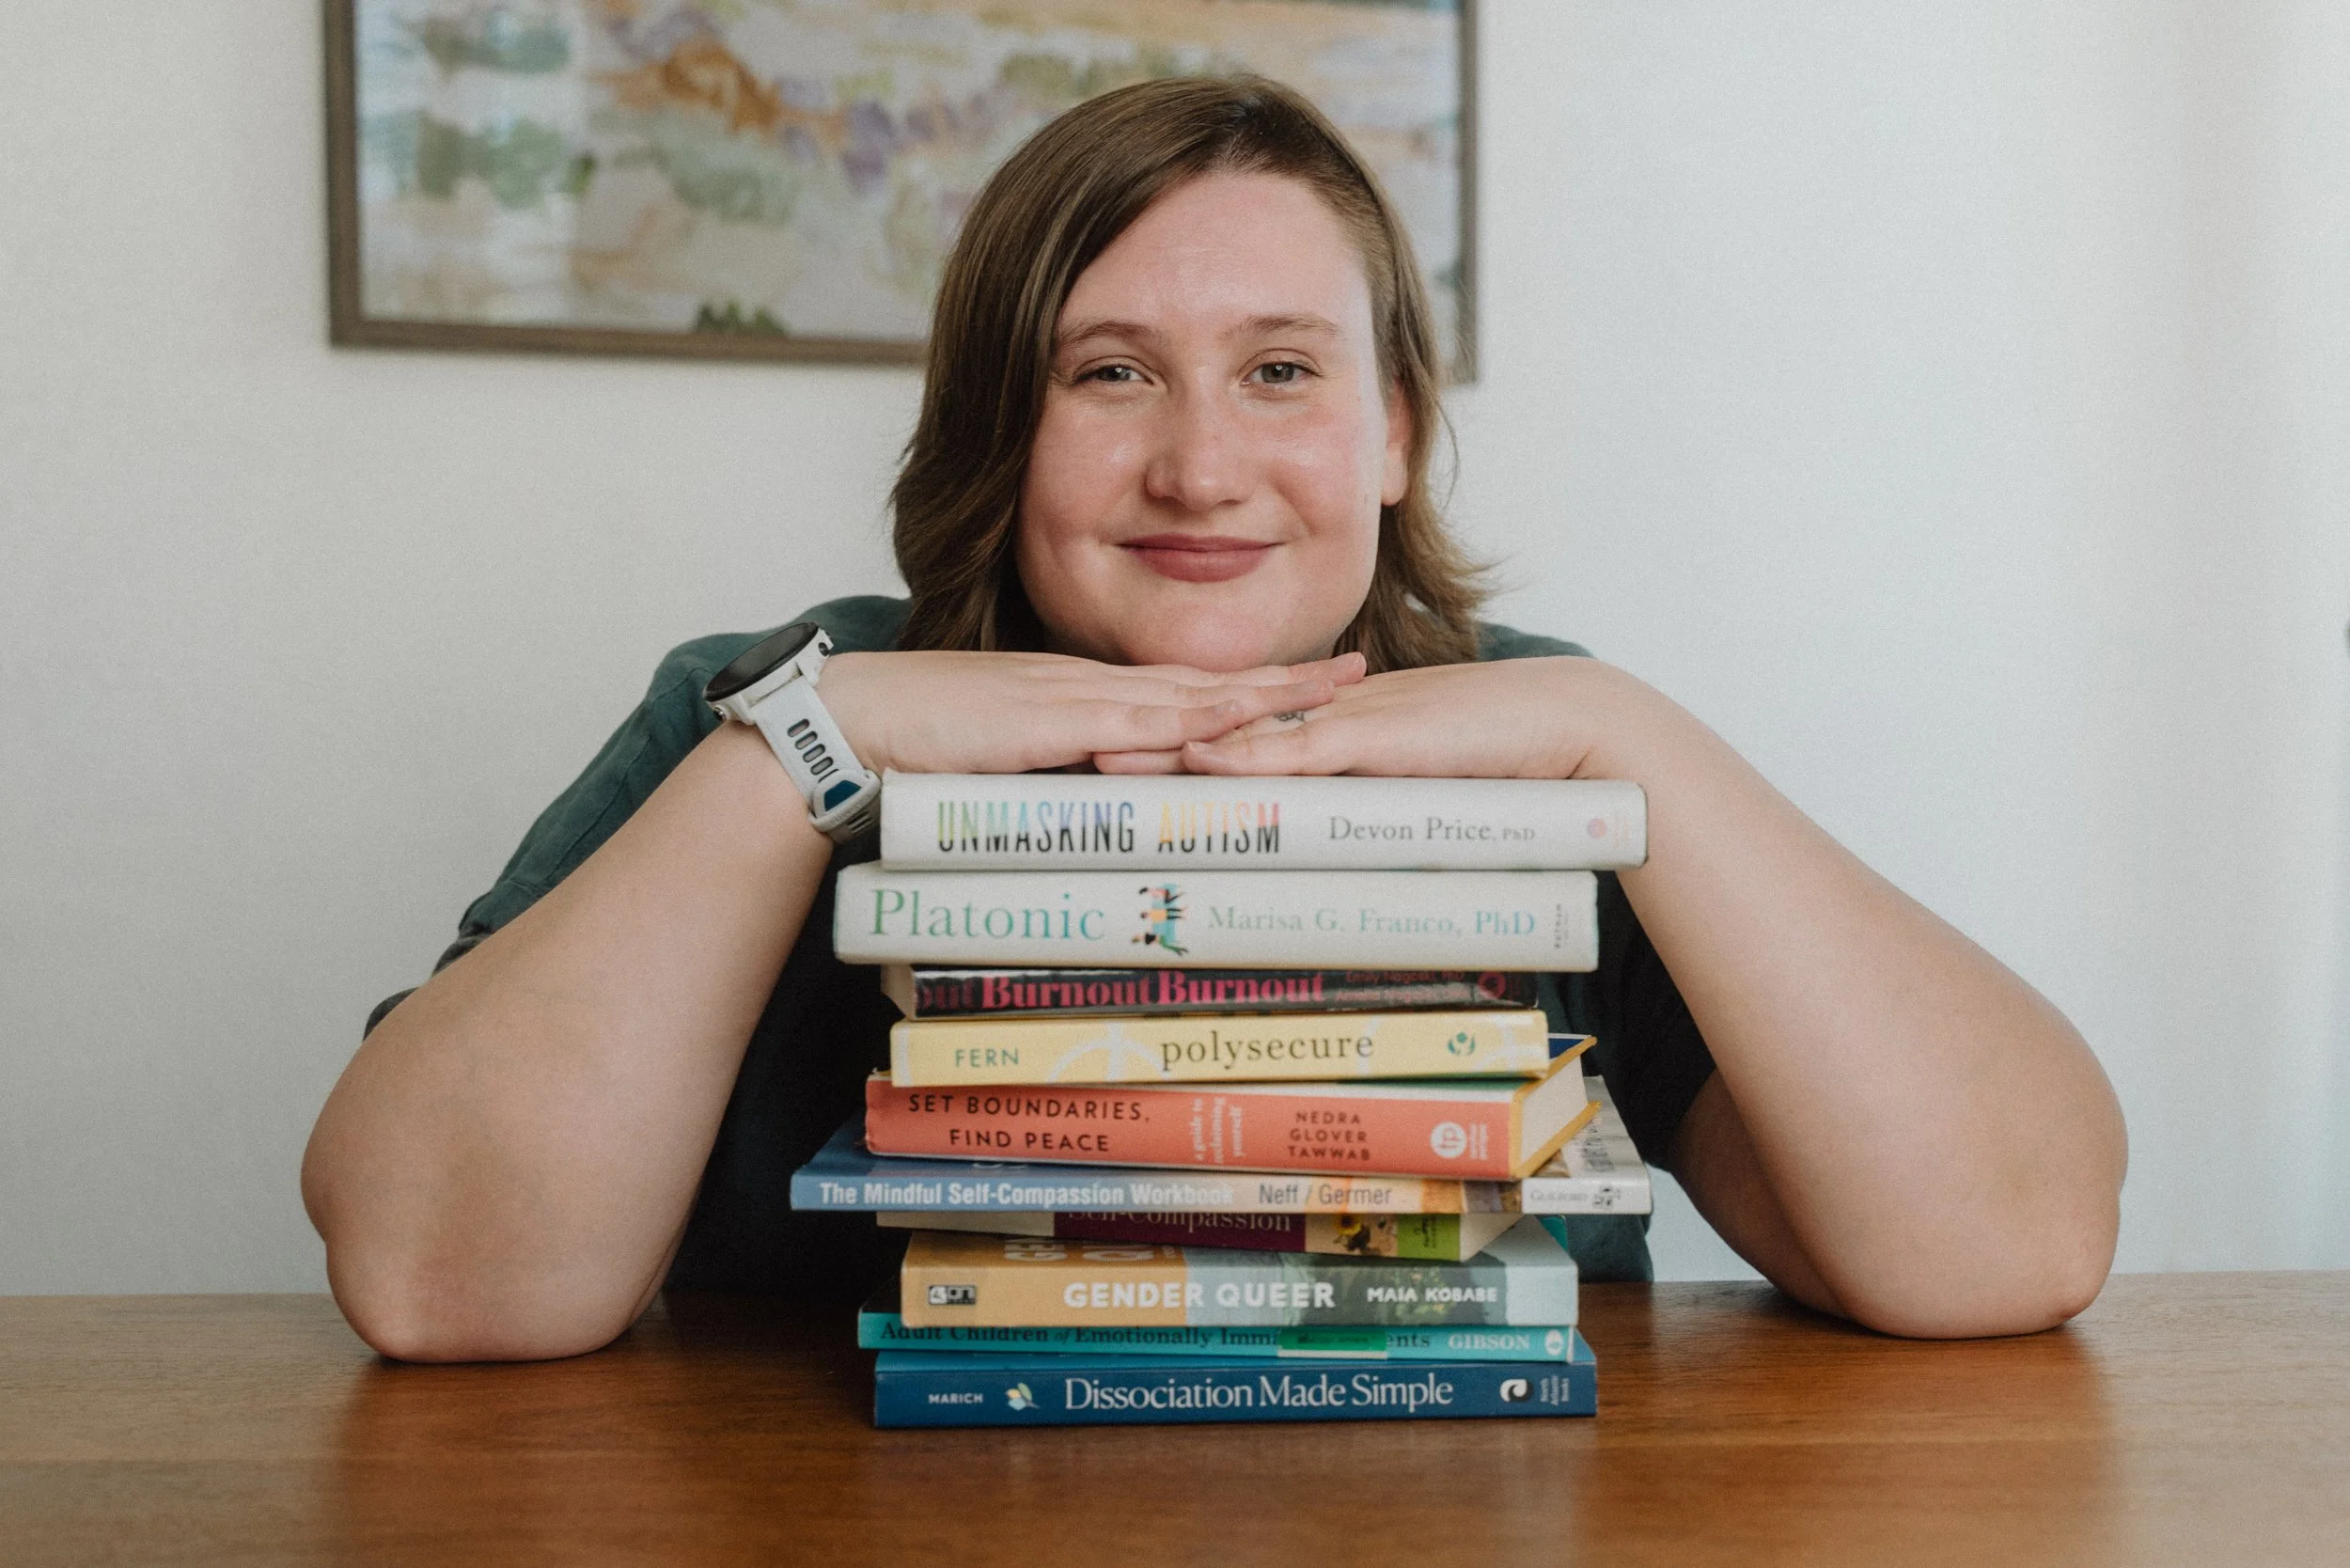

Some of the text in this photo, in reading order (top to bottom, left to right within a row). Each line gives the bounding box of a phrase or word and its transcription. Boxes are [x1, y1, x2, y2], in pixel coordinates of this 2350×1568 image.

[937, 801, 1134, 852] UNMASKING
[1157, 802, 1280, 854] AUTISM
[1330, 816, 1413, 840] Devon
[870, 887, 1104, 940] Platonic
[1208, 906, 1304, 931] Marisa
[1315, 908, 1345, 932] G.
[1359, 908, 1463, 935] Franco,
[1475, 909, 1536, 935] PhD
[980, 975, 1152, 1010] Burnout
[1157, 970, 1324, 1005] Burnout
[954, 1047, 1020, 1070] FERN
[1162, 1030, 1373, 1072] polysecure
[909, 1094, 1151, 1122] SET BOUNDARIES,
[1295, 1111, 1361, 1126] NEDRA
[949, 1129, 1109, 1152] FIND PEACE
[1289, 1128, 1369, 1145] GLOVER
[1288, 1145, 1371, 1162] TAWWAB
[821, 1183, 857, 1205] The
[864, 1183, 942, 1206] Mindful
[948, 1184, 1125, 1211] Self-Compassion
[1127, 1183, 1232, 1208] Workbook
[1259, 1183, 1299, 1206] Neff
[1319, 1183, 1393, 1207] Germer
[1063, 1281, 1337, 1309] GENDER QUEER
[1368, 1287, 1497, 1303] MAIA KOBABE
[948, 1325, 1049, 1343] Children
[1074, 1327, 1214, 1348] Emotionally
[1449, 1334, 1530, 1351] GIBSON
[928, 1392, 984, 1405] MARICH
[1065, 1372, 1454, 1413] Dissociation Made Simple
